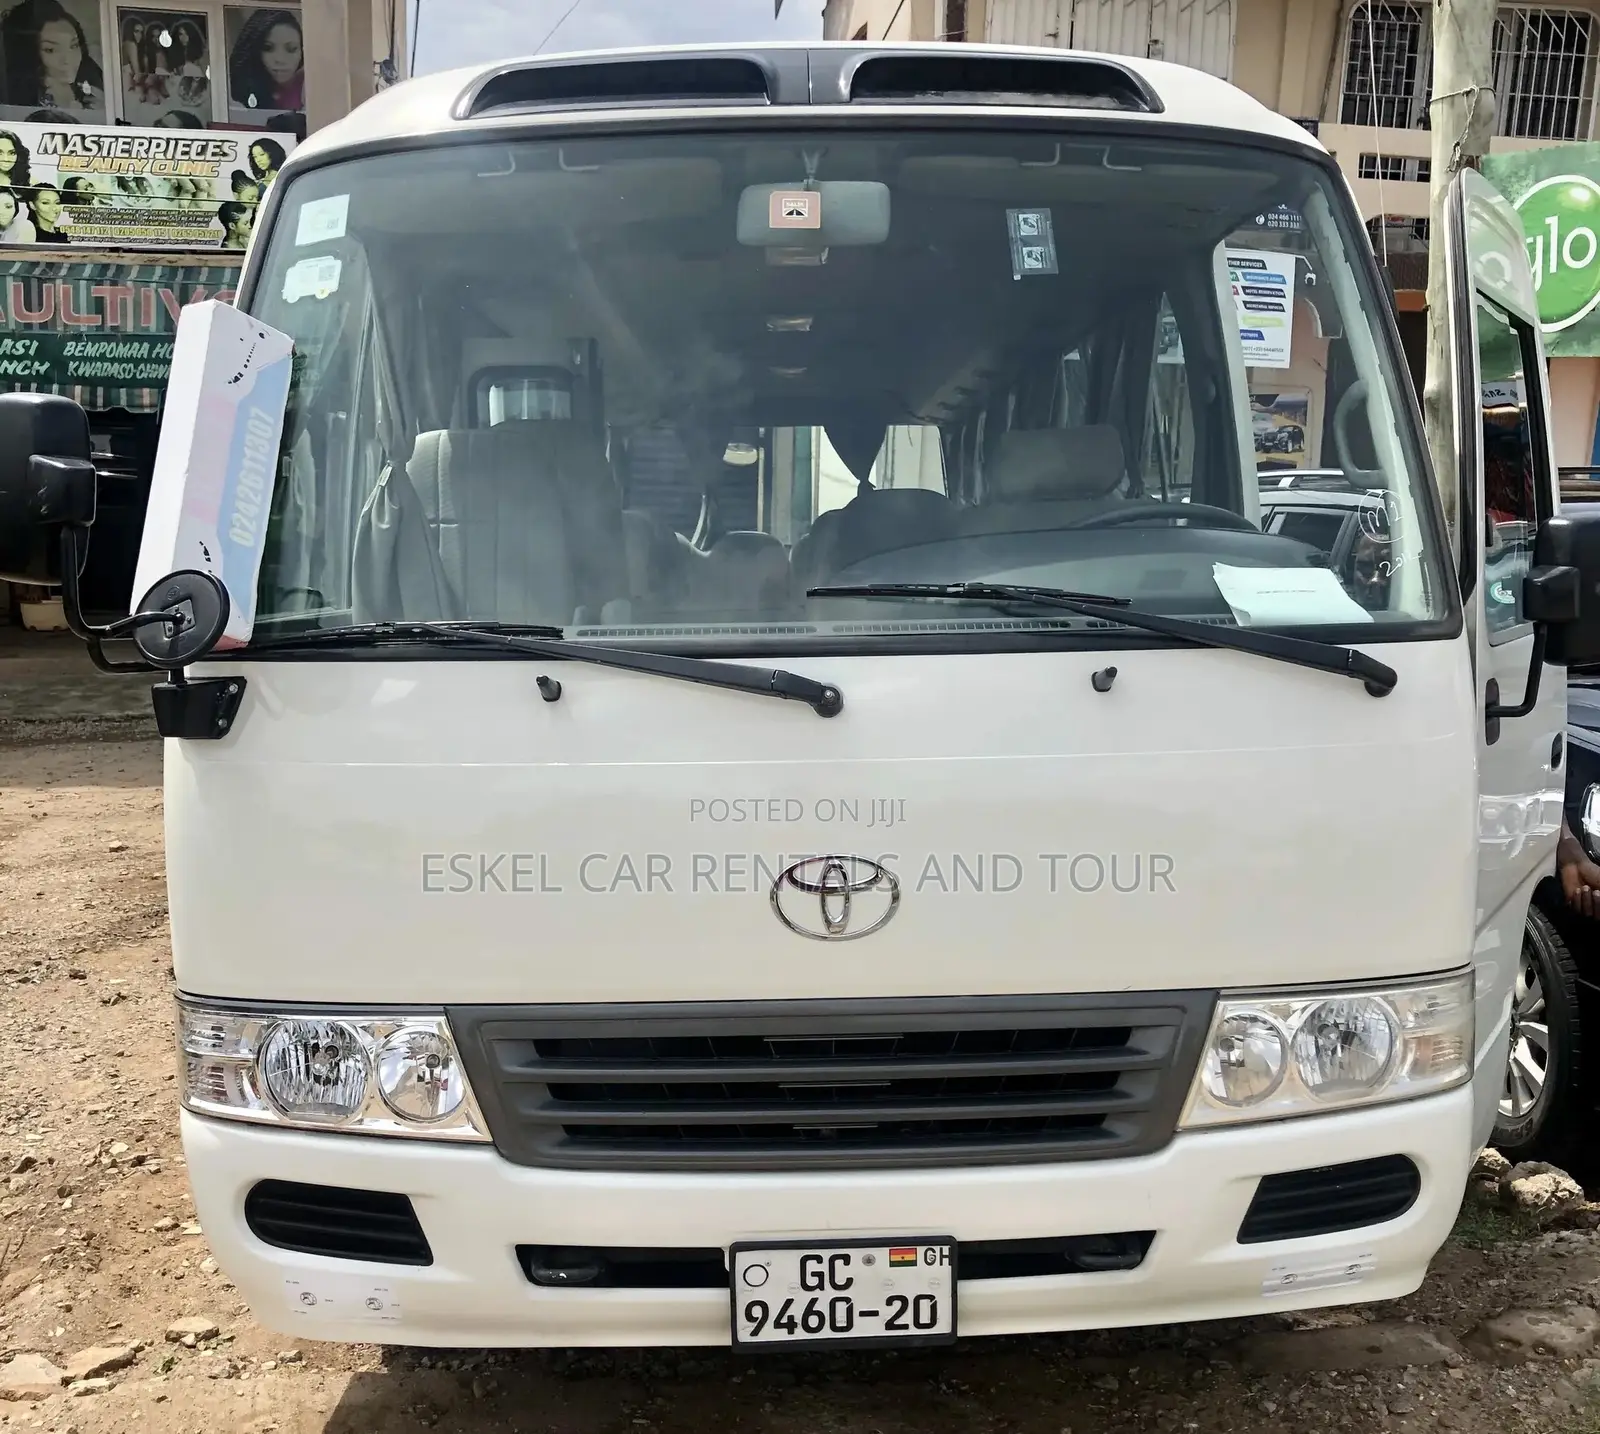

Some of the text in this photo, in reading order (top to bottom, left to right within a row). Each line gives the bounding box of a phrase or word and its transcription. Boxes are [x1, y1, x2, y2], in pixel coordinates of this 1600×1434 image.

[37, 132, 238, 162] MASTERPIECES
[58, 155, 222, 178] BEAUTY CLINIC
[63, 341, 150, 359] BEMPOMAA
[229, 408, 274, 546] 0242611307
[800, 1246, 952, 1292] GC GH
[744, 1293, 938, 1337] 9460-20
